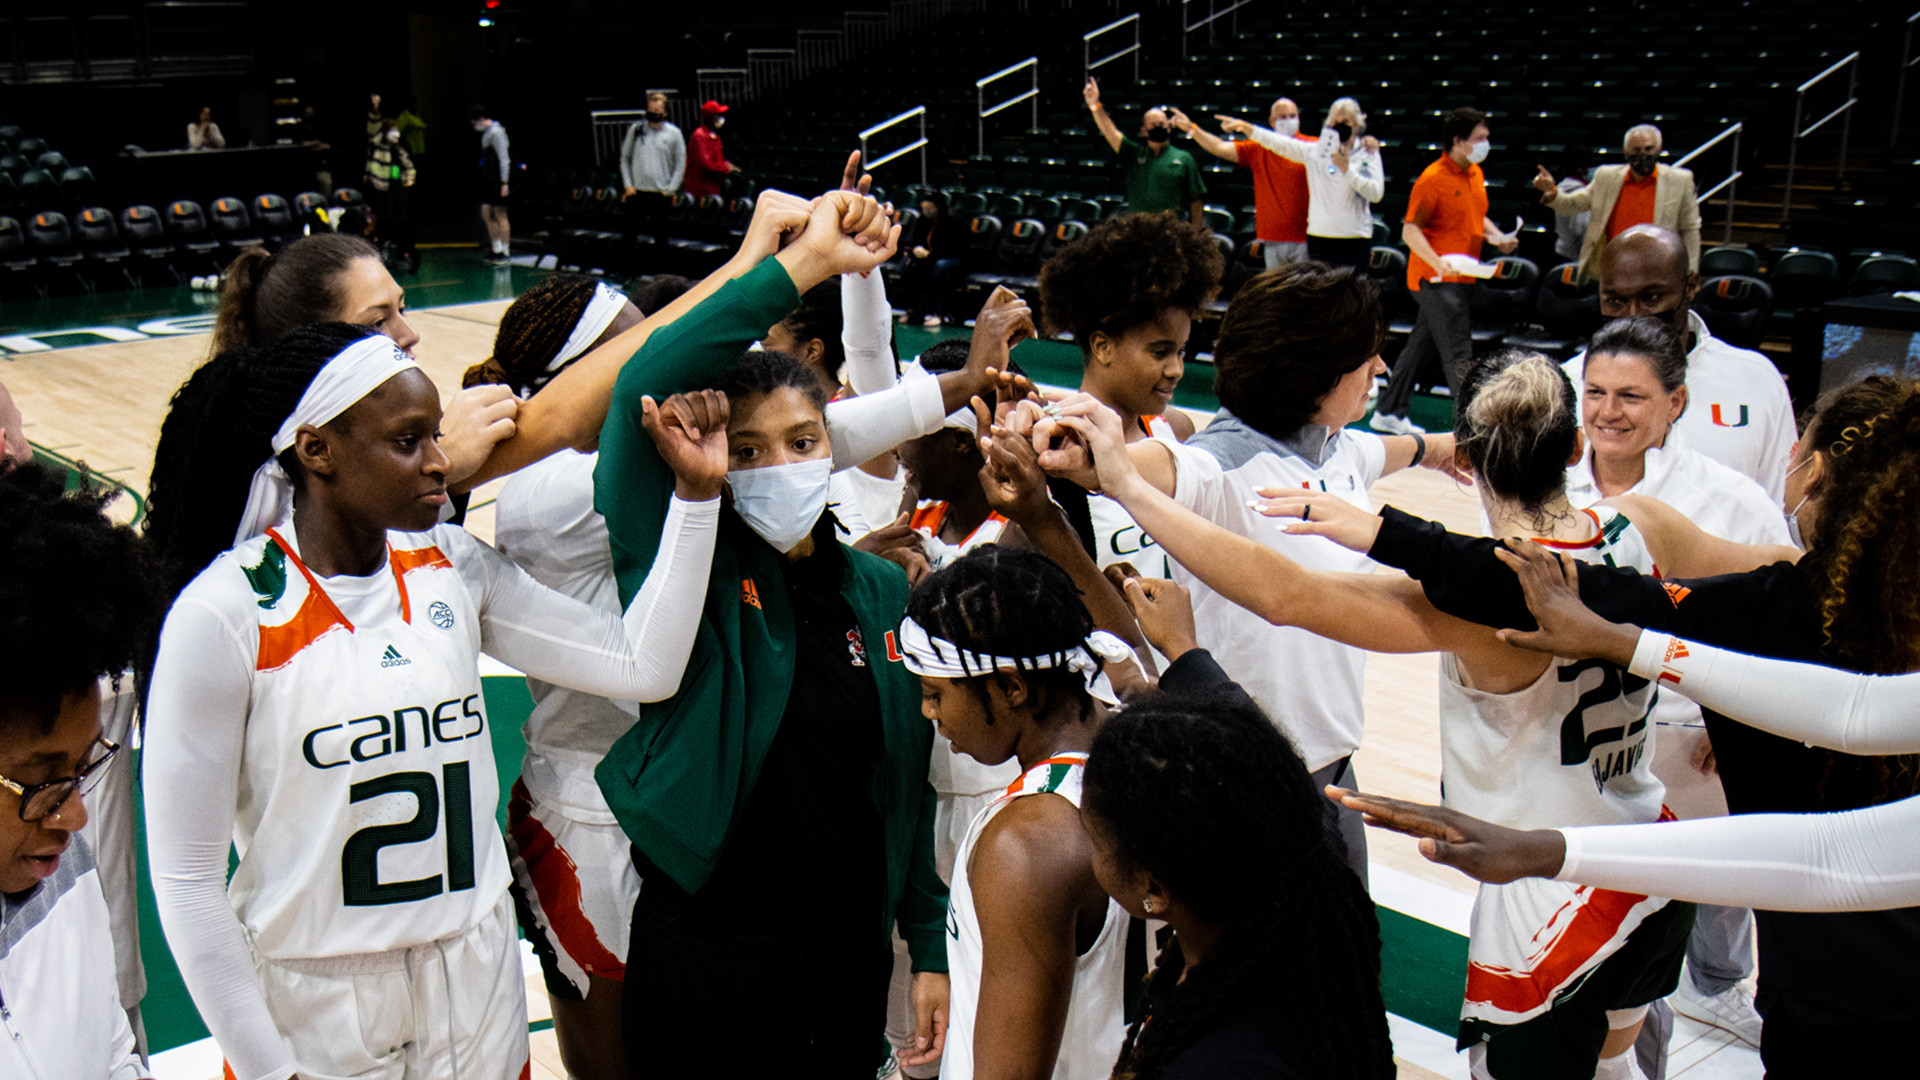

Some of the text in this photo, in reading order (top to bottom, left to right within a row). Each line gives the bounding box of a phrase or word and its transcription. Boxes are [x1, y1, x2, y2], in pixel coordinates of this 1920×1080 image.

[1710, 403, 1749, 428] U
[433, 608, 453, 620] ACC
[381, 658, 412, 668] adidas
[341, 760, 476, 906] 21
